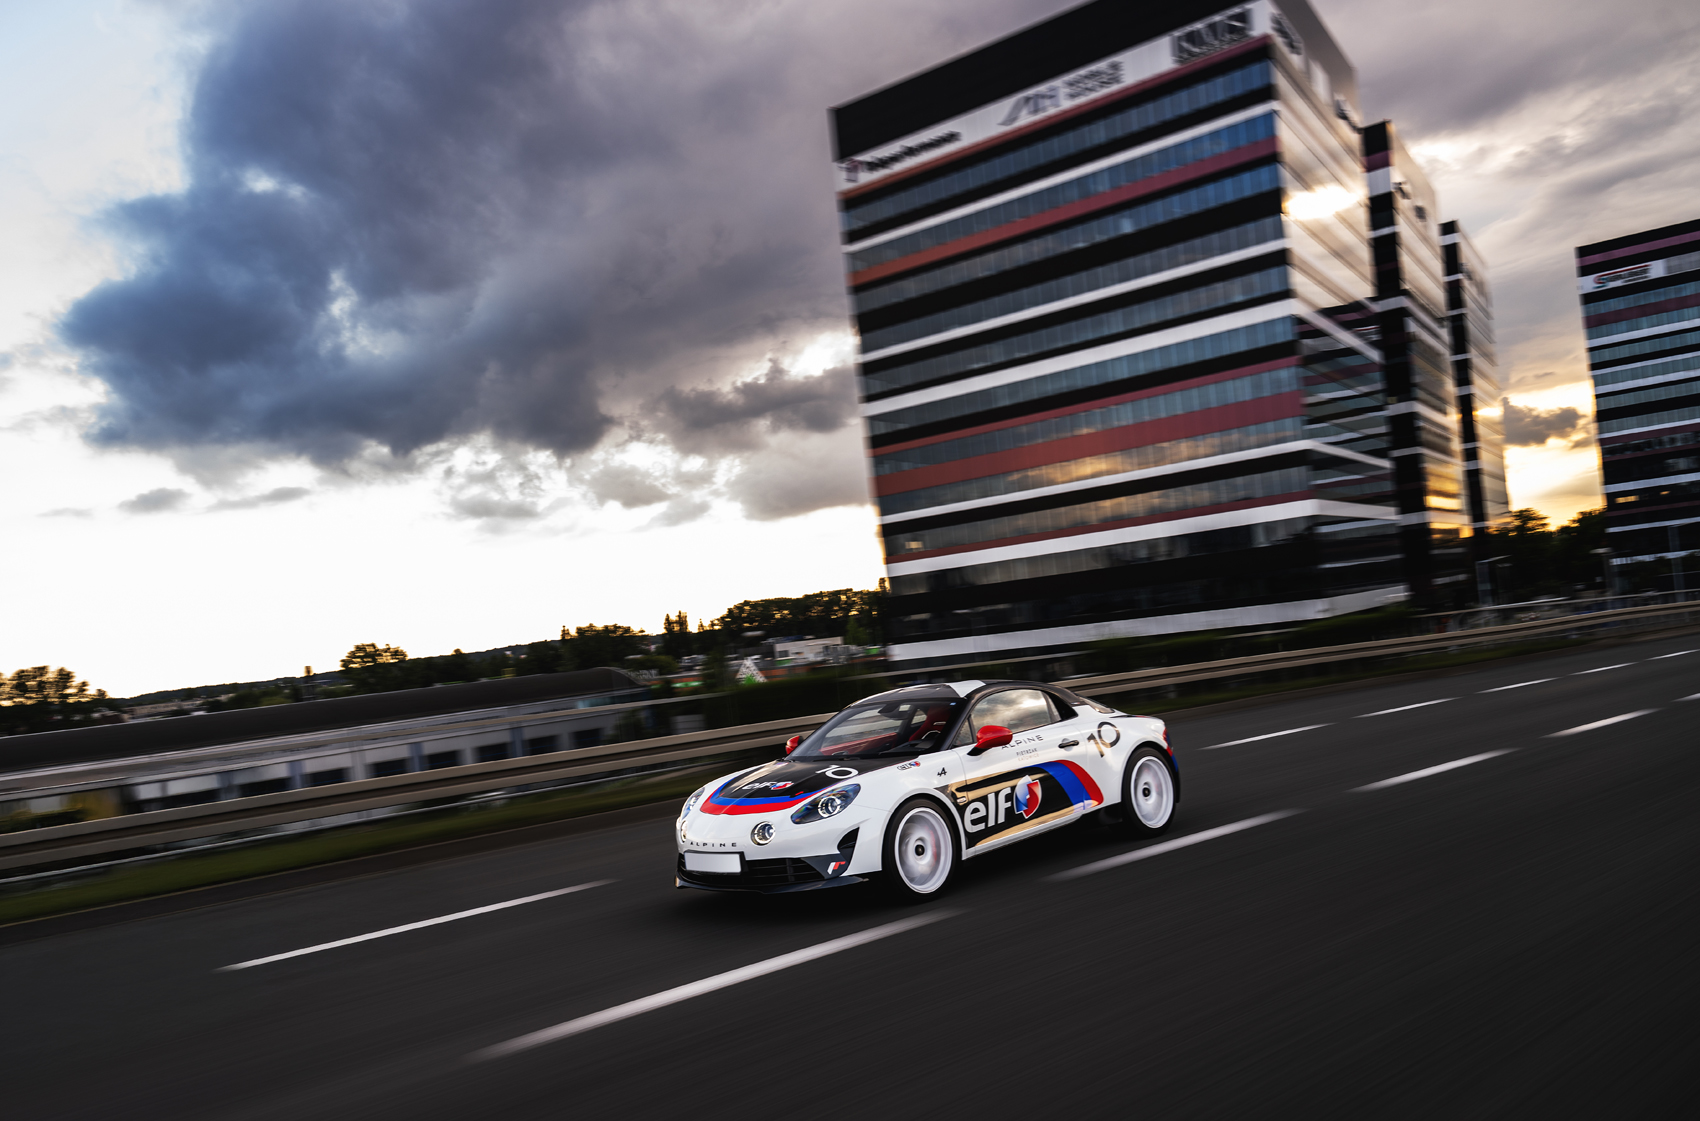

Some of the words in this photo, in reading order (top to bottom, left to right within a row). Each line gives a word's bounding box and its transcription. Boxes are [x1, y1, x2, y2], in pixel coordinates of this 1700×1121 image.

[1001, 734, 1044, 750] ALPINE
[1087, 721, 1121, 758] 10
[815, 764, 859, 779] 10
[963, 786, 1012, 833] elf
